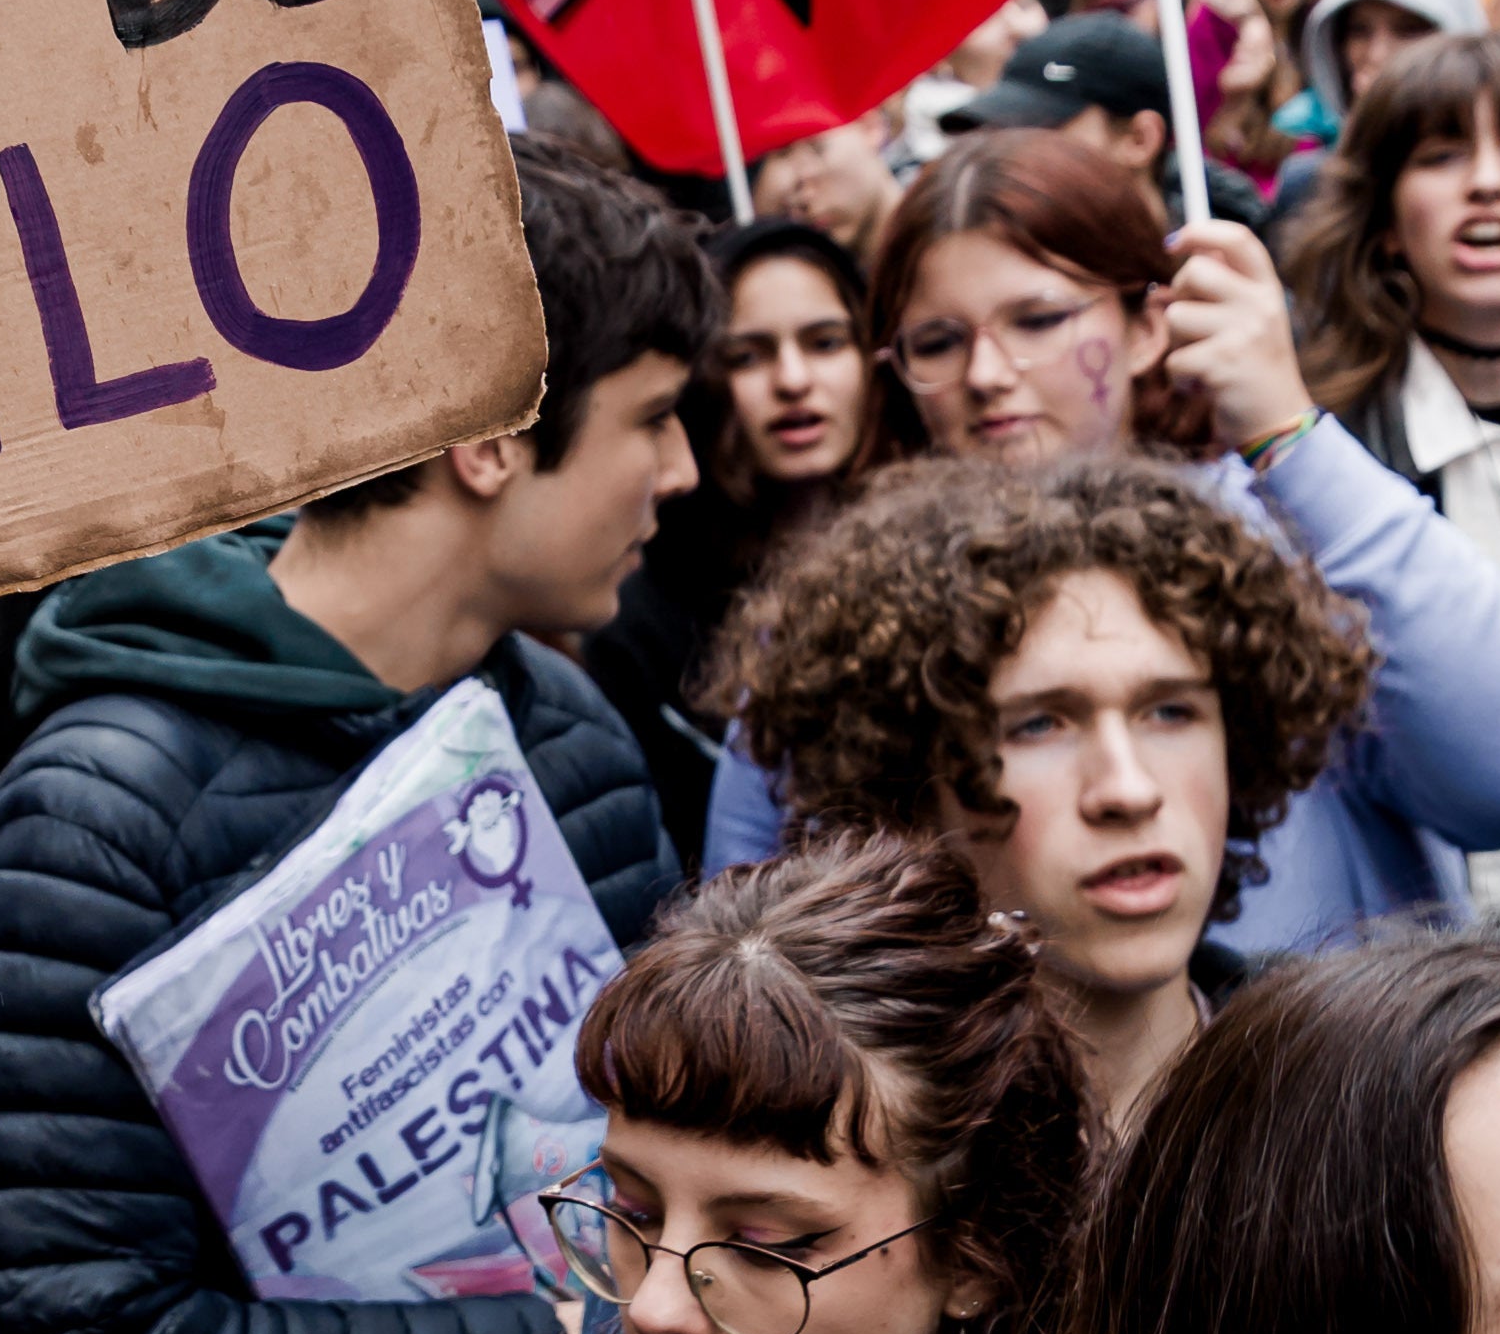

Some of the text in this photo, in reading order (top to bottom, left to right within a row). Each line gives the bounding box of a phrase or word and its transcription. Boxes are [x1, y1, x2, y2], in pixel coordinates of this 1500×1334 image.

[224, 879, 453, 1091] Combativas
[253, 872, 371, 1022] Libres
[378, 842, 407, 899] y
[258, 945, 600, 1274] PALESTINA
[319, 1013, 476, 1154] antifascistas
[477, 969, 514, 1017] con
[340, 973, 470, 1101] Feministas
